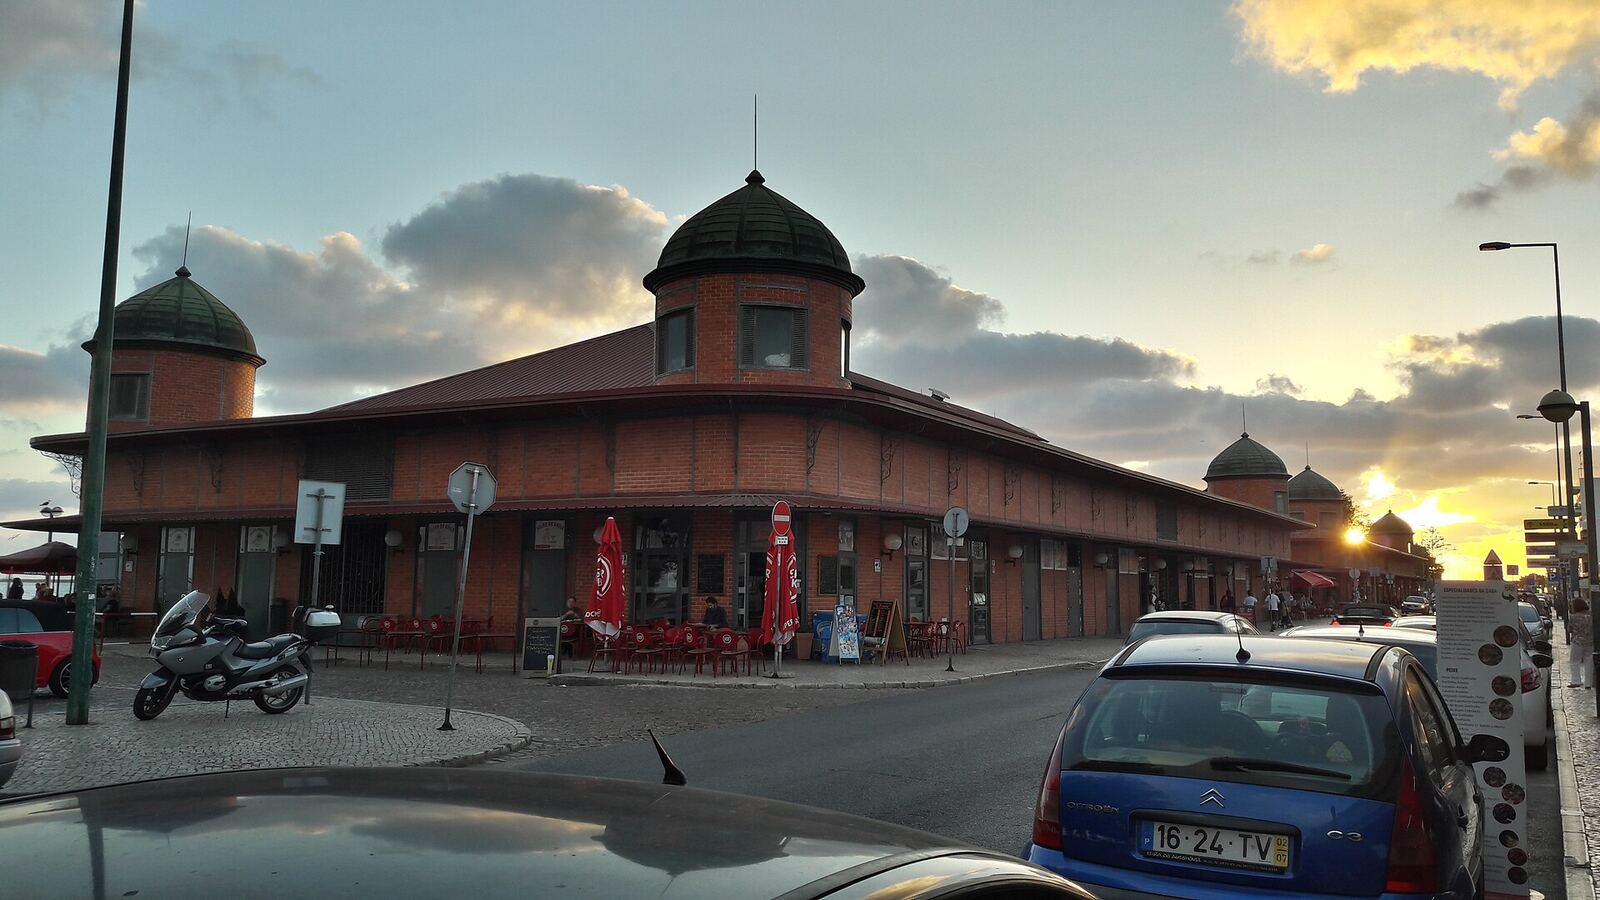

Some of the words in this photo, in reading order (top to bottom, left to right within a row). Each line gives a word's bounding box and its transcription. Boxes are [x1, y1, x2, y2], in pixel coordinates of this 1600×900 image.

[1327, 830, 1362, 841] C3
[1276, 837, 1288, 847] 02
[1276, 853, 1287, 863] 07
